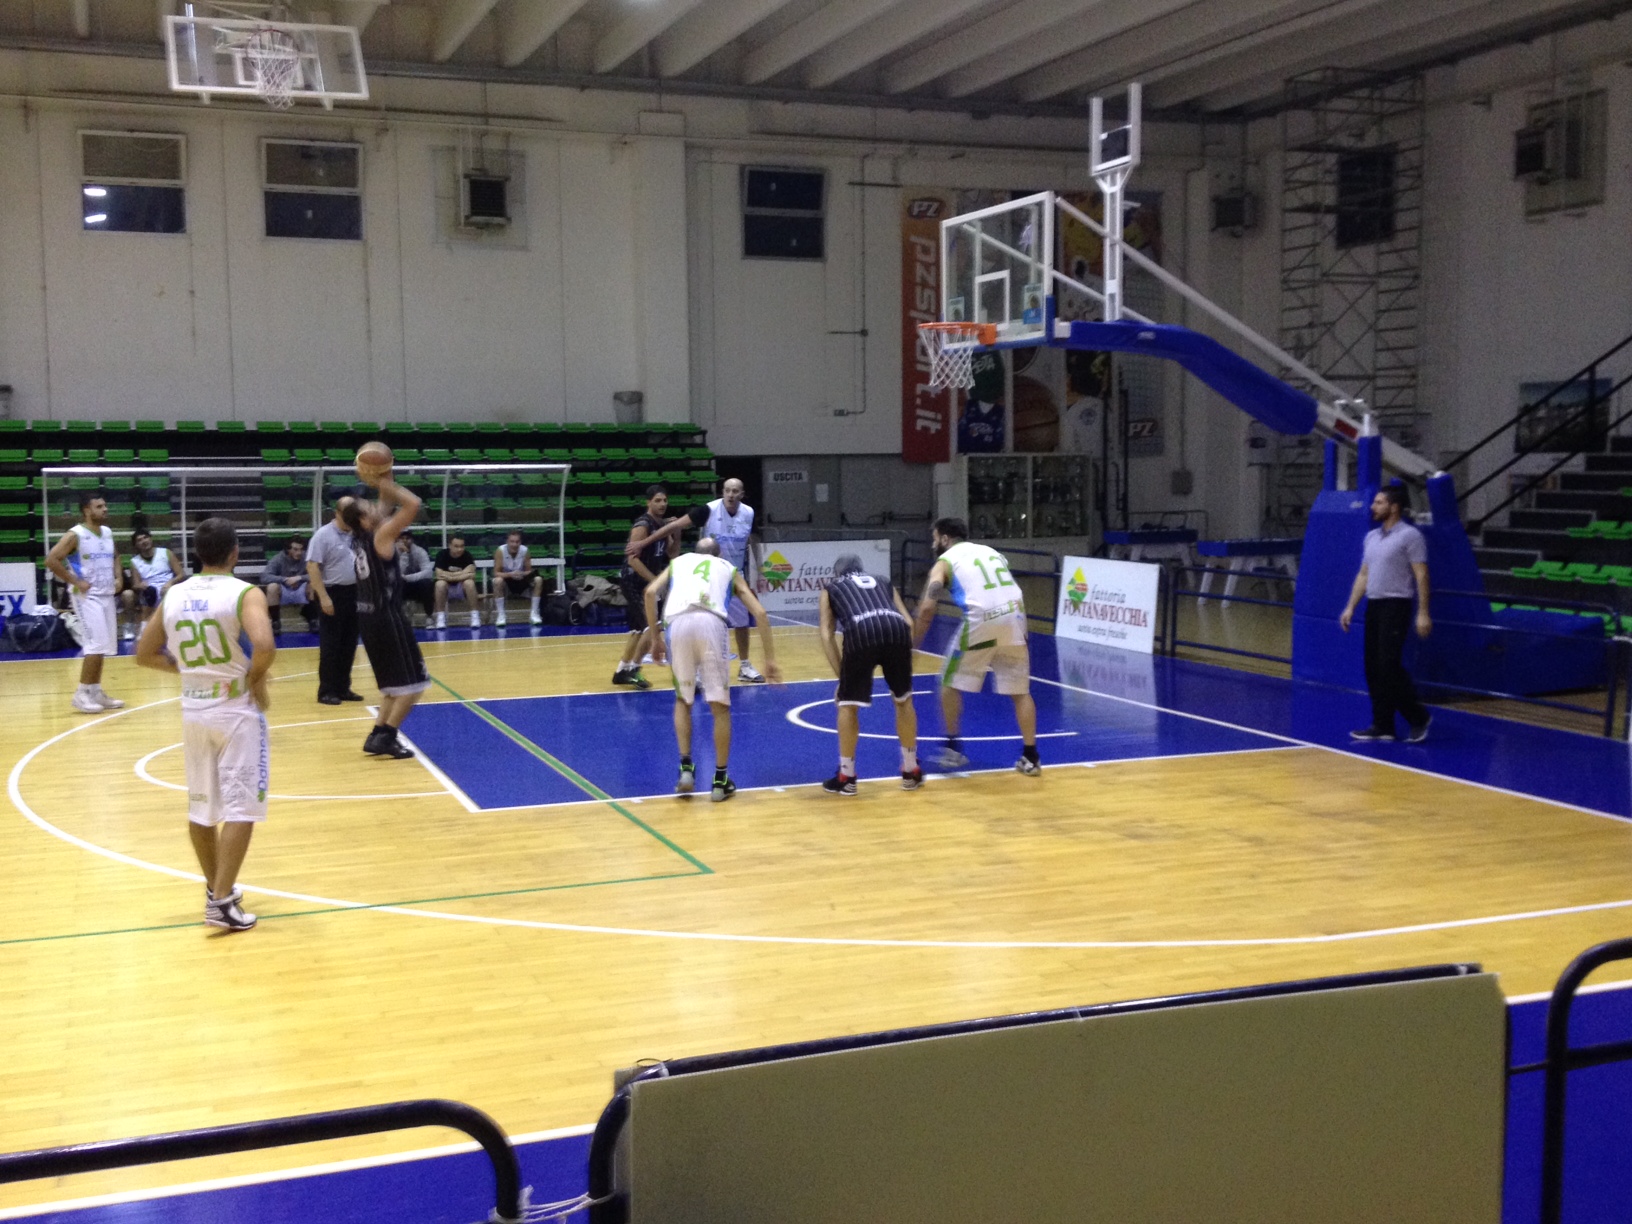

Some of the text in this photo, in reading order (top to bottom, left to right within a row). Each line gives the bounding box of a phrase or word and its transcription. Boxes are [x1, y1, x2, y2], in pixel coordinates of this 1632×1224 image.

[912, 201, 940, 217] PZ
[1127, 421, 1154, 437] PZ
[773, 472, 803, 482] USCITA
[692, 559, 712, 583] 4
[974, 554, 1014, 590] 12
[757, 576, 836, 594] FONTANAV
[1091, 584, 1126, 604] fattoria
[1063, 599, 1148, 628] FONTANAVECCHIA
[175, 618, 232, 668] 20
